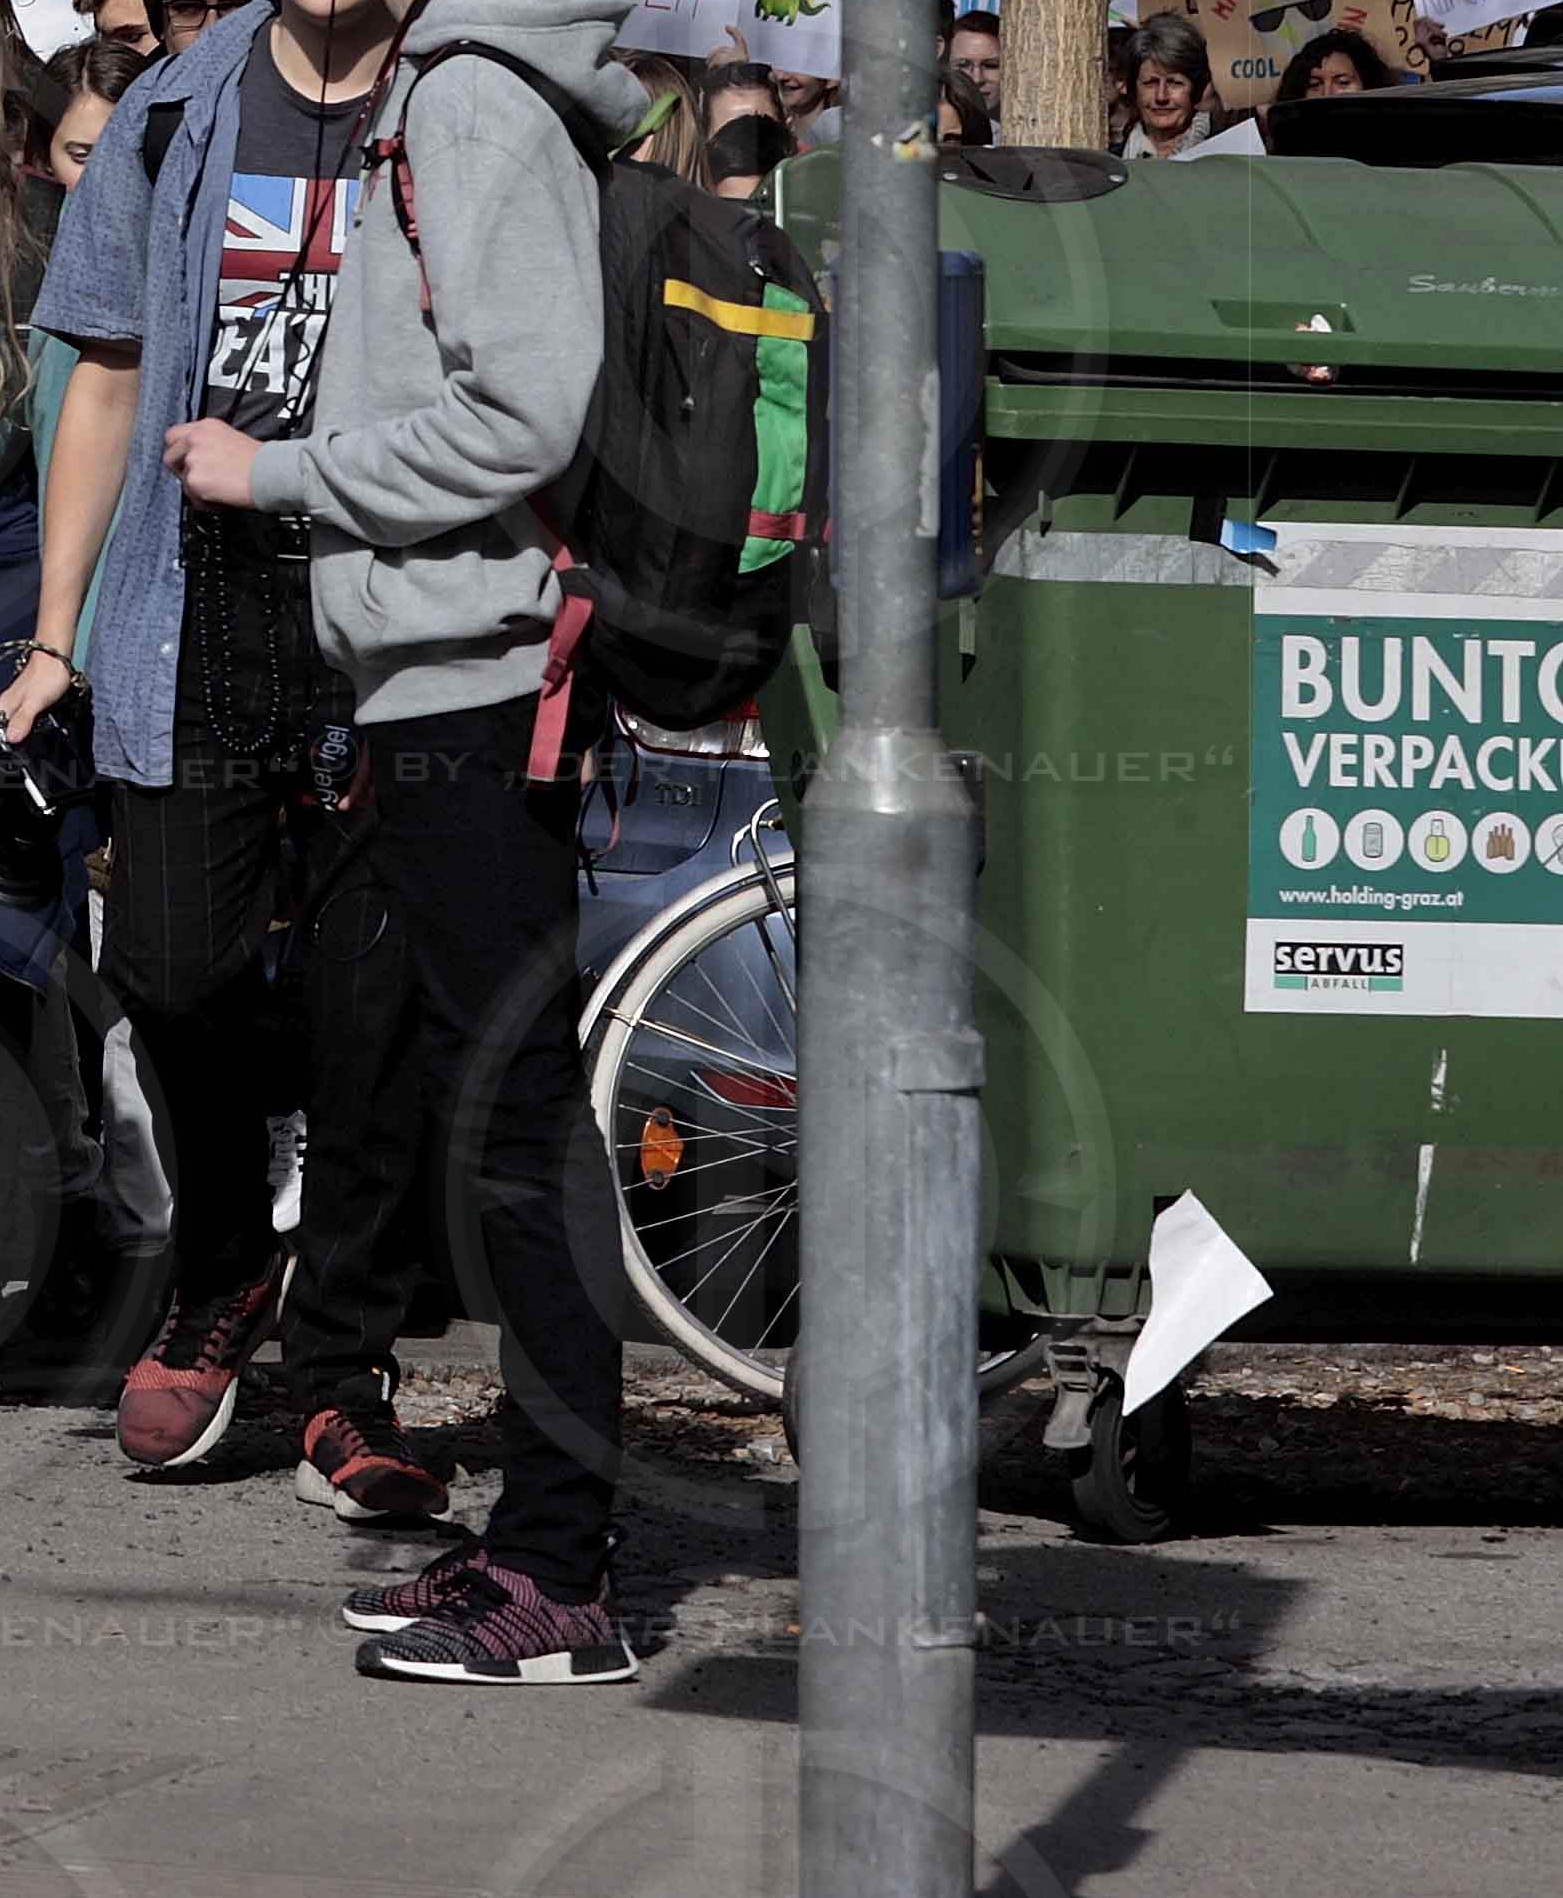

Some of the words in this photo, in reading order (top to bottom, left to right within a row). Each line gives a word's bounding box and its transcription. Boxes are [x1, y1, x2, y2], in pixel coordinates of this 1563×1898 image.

[1230, 57, 1281, 80] COOL
[1278, 884, 1465, 910] www.holding-graz.at
[1275, 944, 1403, 974] servus
